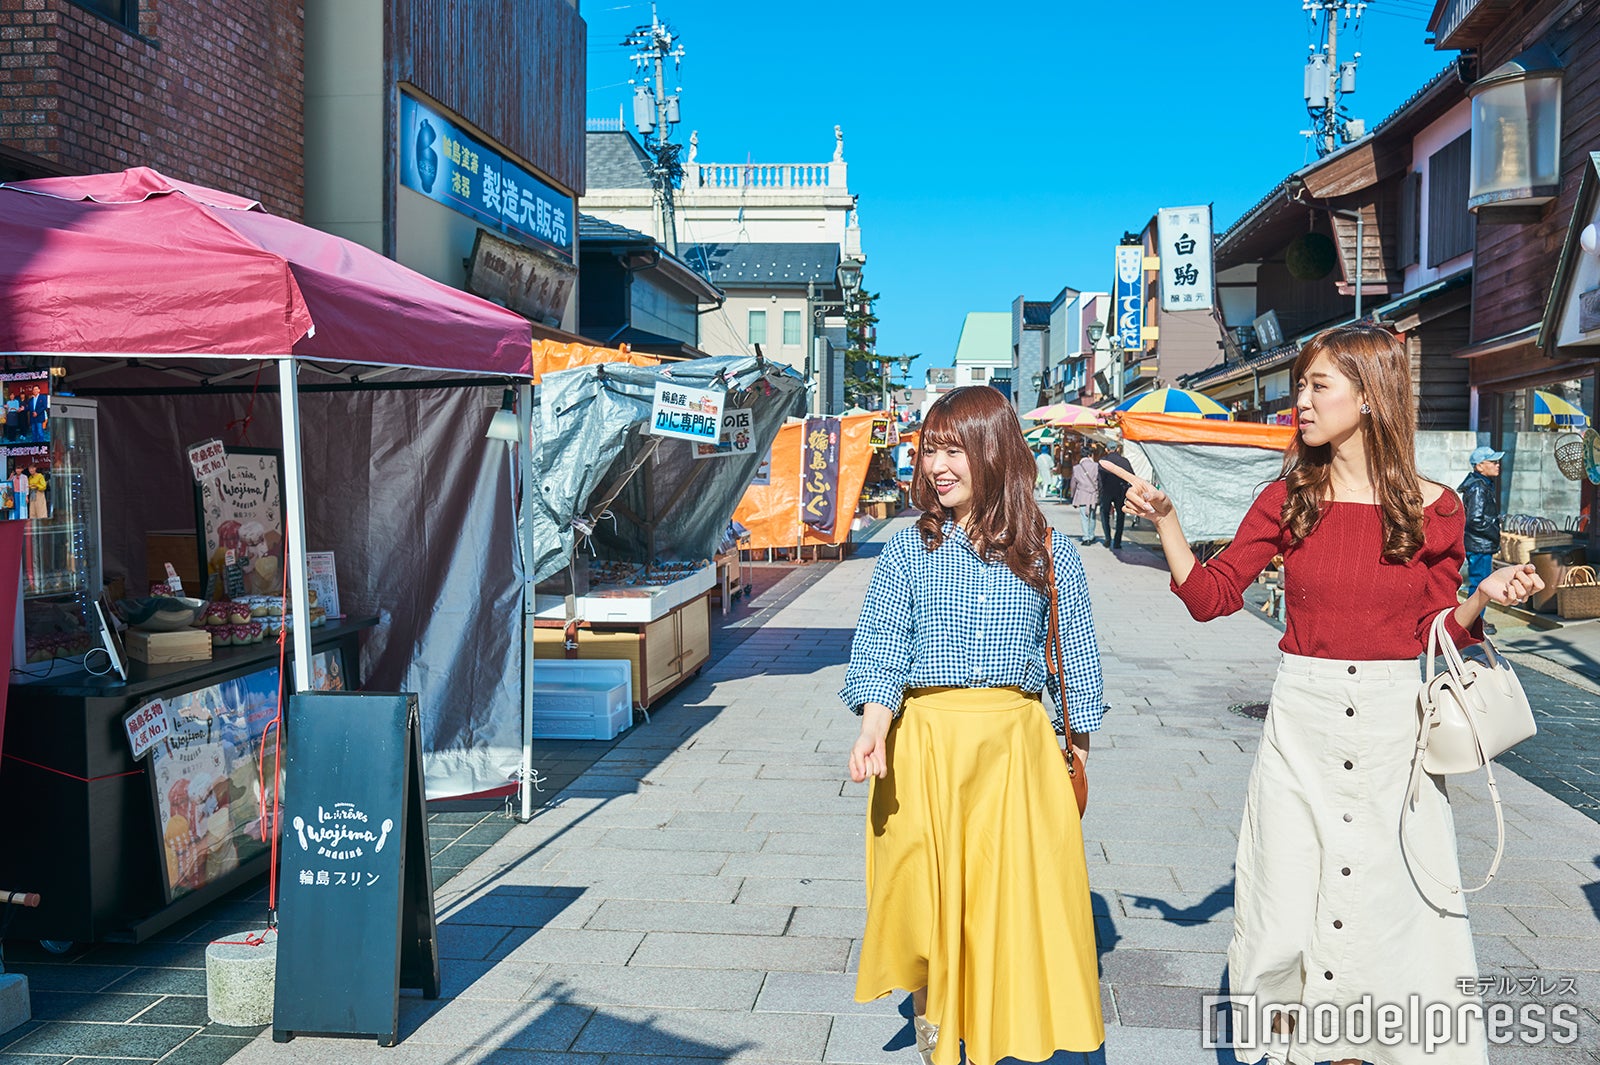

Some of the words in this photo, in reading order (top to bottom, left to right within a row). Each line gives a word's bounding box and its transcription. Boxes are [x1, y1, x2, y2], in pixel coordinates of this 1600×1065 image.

[482, 164, 567, 247] 製造元販売
[1174, 233, 1199, 286] 白駒
[661, 390, 688, 406] 輪島産
[657, 408, 716, 435] かに専門店
[721, 413, 750, 428] の店
[806, 428, 831, 517] 輪島ふぐ
[128, 703, 163, 735] 輪島名物
[299, 869, 380, 887] 輪島プリン
